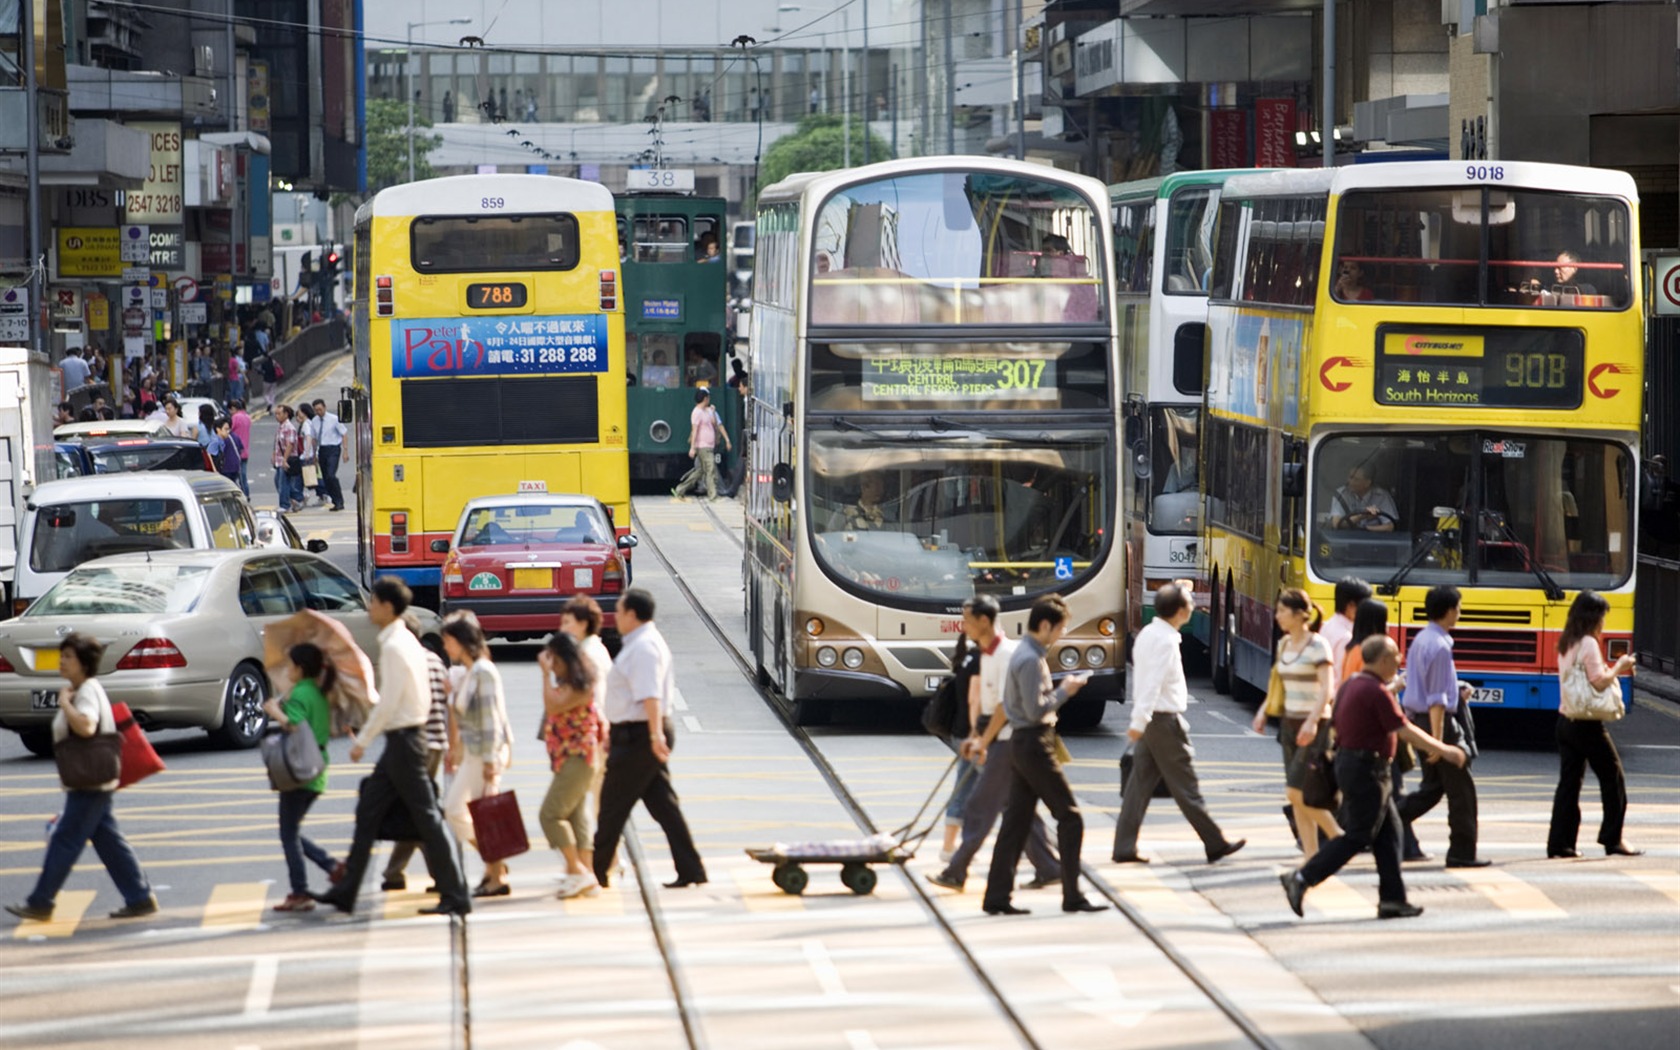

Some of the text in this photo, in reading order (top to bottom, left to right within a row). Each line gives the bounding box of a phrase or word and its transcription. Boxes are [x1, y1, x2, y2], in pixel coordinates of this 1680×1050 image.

[160, 165, 180, 183] LET
[648, 171, 674, 187] 38
[1466, 166, 1504, 180] 9018
[66, 190, 109, 208] DBS
[128, 195, 181, 213] 2547 3218
[481, 197, 505, 209] 859
[481, 287, 512, 303] 788
[539, 348, 566, 363] 288
[570, 347, 597, 362] 288
[997, 360, 1046, 390] 307
[1505, 353, 1566, 388] 90B
[907, 374, 957, 385] CENTRAL
[873, 384, 996, 396] CENTRAL FERRY PIERS
[1386, 387, 1479, 403] South Horizons
[520, 482, 545, 490] TAXI
[1471, 689, 1502, 702] 479
